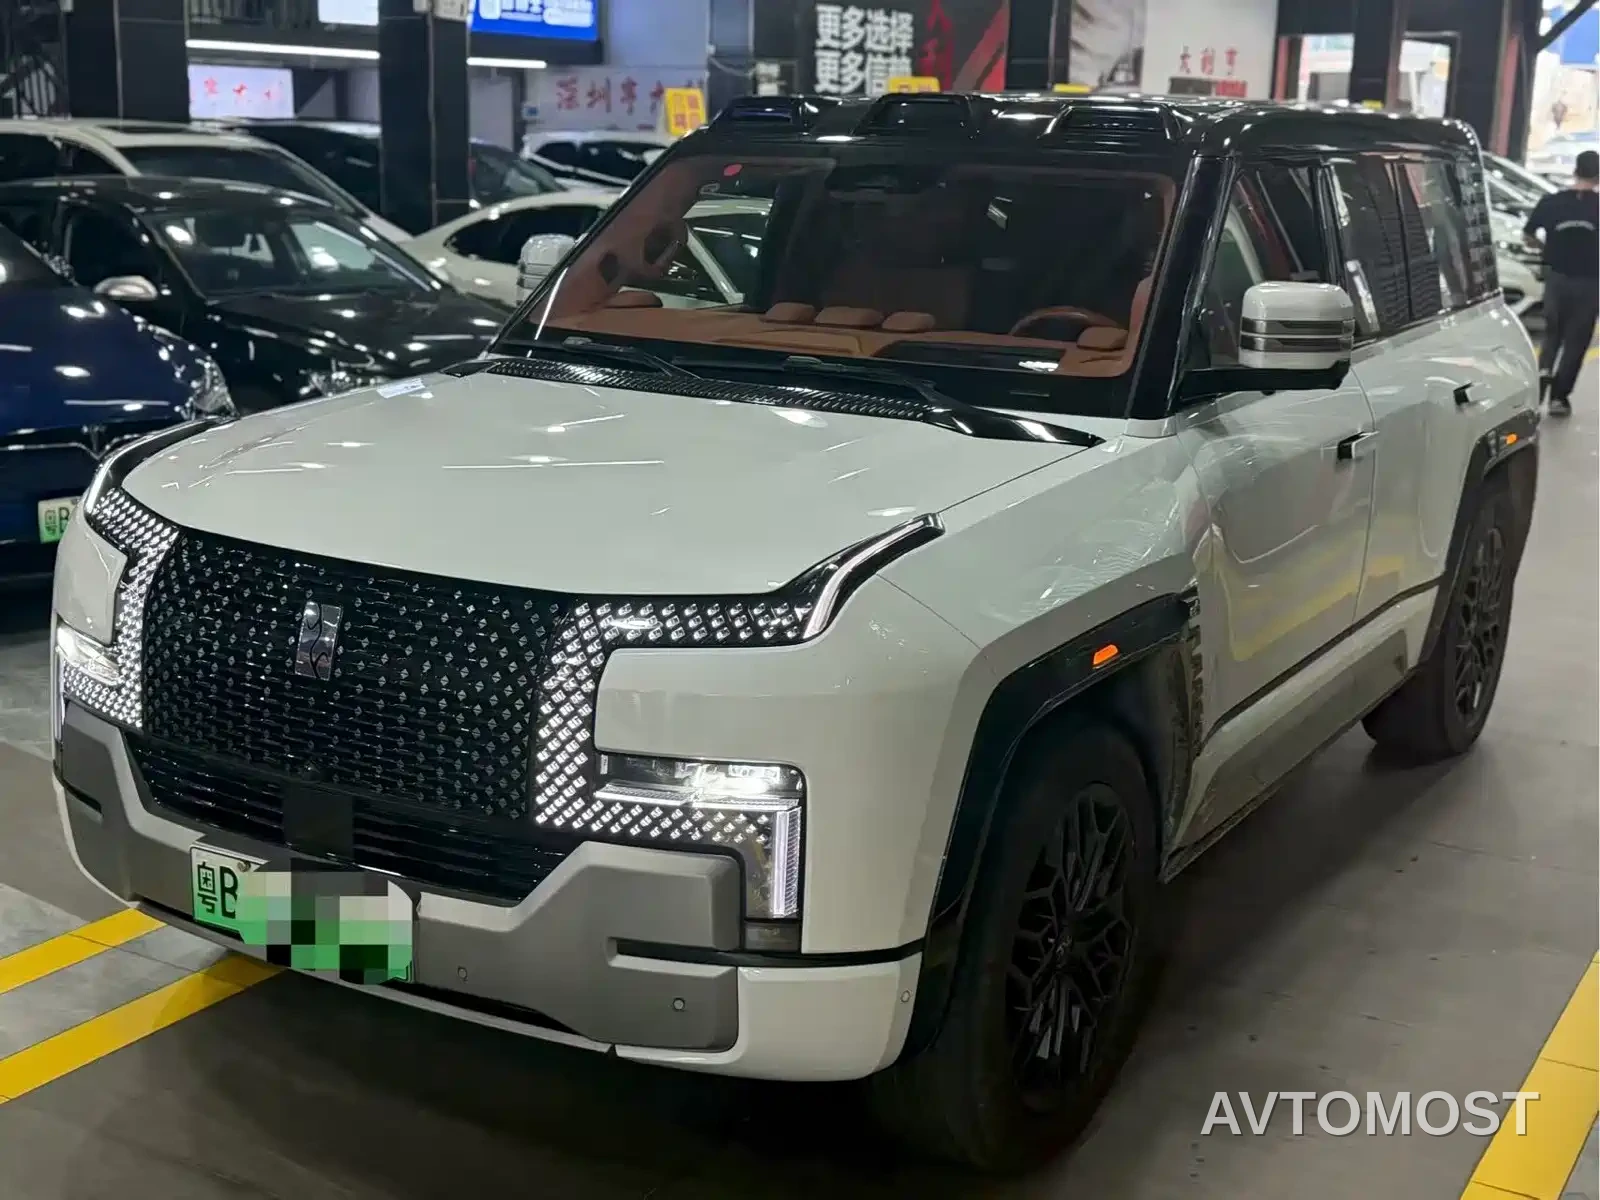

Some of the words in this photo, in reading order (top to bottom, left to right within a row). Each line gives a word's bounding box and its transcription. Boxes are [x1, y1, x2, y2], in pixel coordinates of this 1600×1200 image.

[814, 4, 914, 54] 更多选择
[197, 861, 239, 920] 粤B
